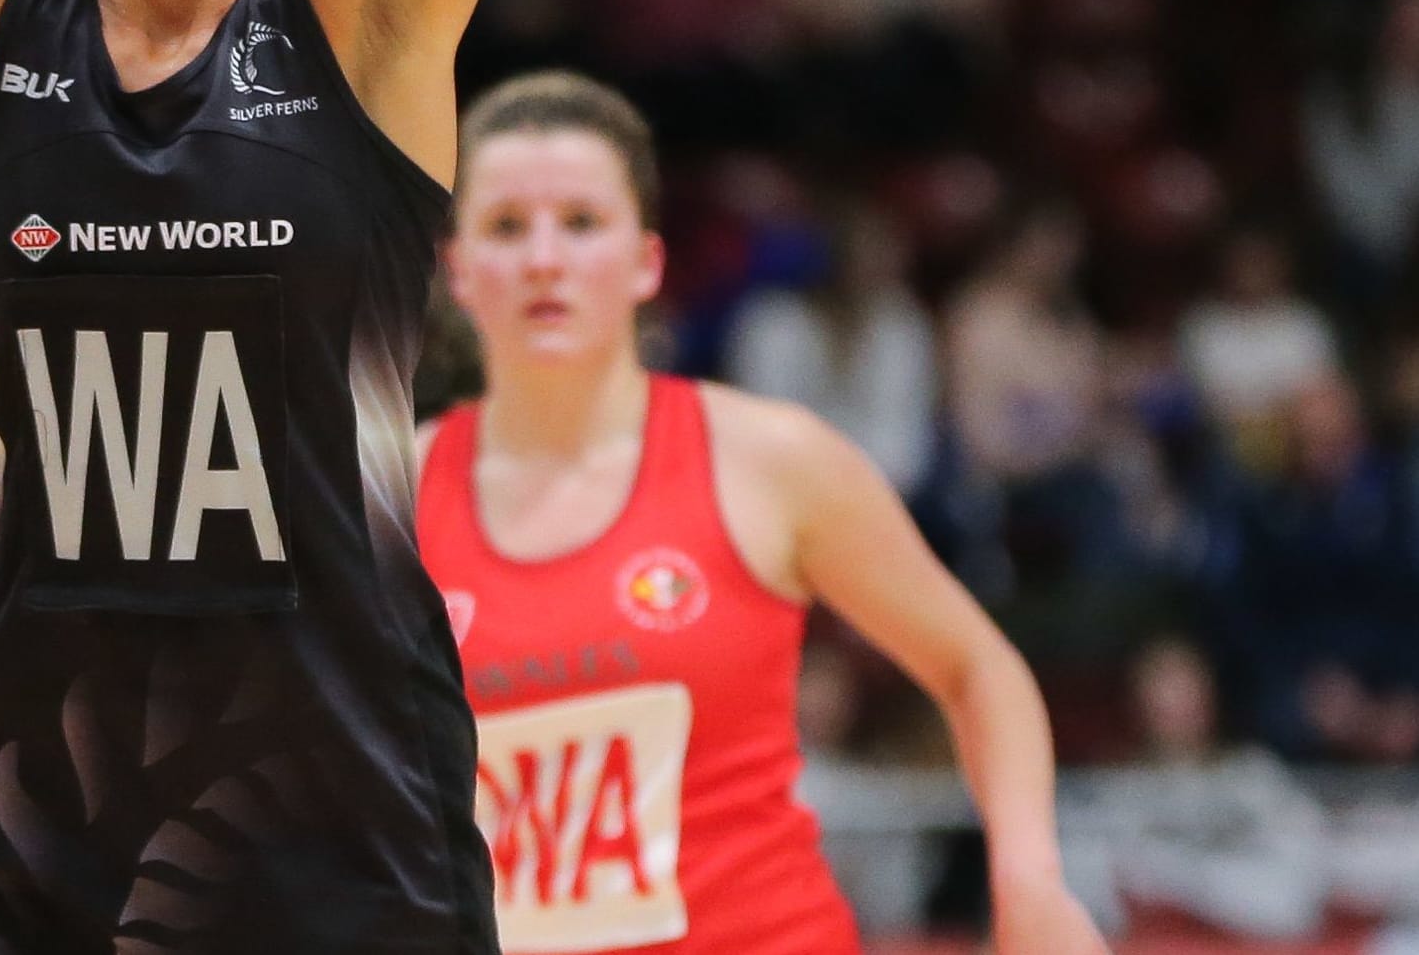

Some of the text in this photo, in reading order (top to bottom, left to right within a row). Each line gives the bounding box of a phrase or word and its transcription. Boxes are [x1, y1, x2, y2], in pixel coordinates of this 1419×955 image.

[0, 63, 75, 103] BUK
[229, 96, 319, 121] SILVER FERNS
[20, 230, 50, 245] NW
[68, 219, 295, 252] NEW WORLD
[16, 328, 287, 562] WA
[476, 736, 652, 907] WA
